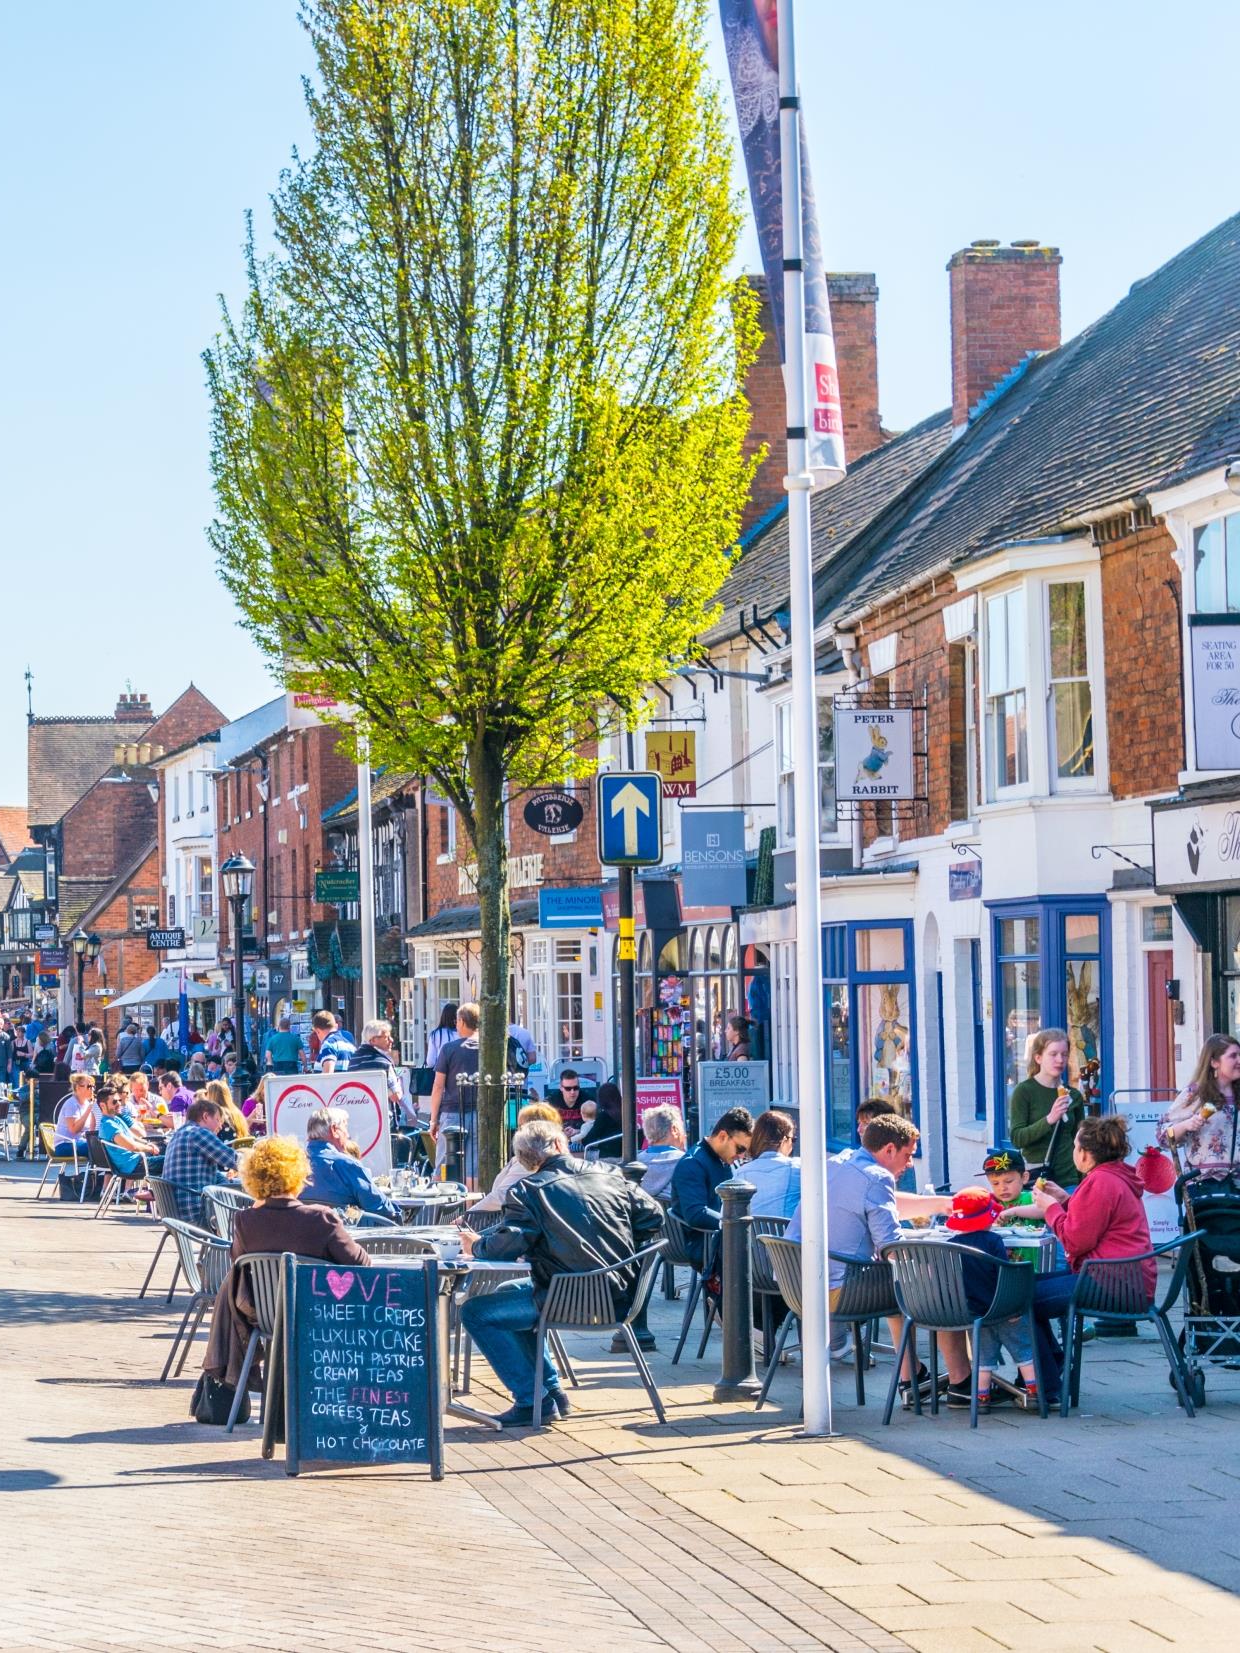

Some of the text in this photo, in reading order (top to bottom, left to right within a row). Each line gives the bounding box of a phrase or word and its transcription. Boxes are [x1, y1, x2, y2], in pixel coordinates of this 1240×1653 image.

[1202, 641, 1237, 650] SEATING
[1208, 651, 1232, 661] AREA
[1206, 661, 1235, 671] FOR 50
[854, 715, 895, 724] PETER
[852, 785, 899, 795] RABBIT
[684, 849, 744, 862] BENSONS
[546, 896, 562, 905] THE
[149, 932, 183, 940] ANTIQUE
[273, 975, 284, 984] 47
[714, 1067, 749, 1079] £5.00
[709, 1079, 755, 1087] BREAKFAST
[287, 1094, 370, 1109] Love Drinks
[636, 1096, 677, 1104] ASHMERE
[313, 1303, 425, 1327] SWEET CREPES
[312, 1328, 422, 1352] LUXURY CAKE
[313, 1349, 425, 1368] DANISH PASTRIES
[314, 1366, 404, 1383] CREAM TEAS
[314, 1386, 347, 1403] THE
[369, 1407, 411, 1427] TEAS
[316, 1436, 425, 1451] HOT CHOCOLATE
